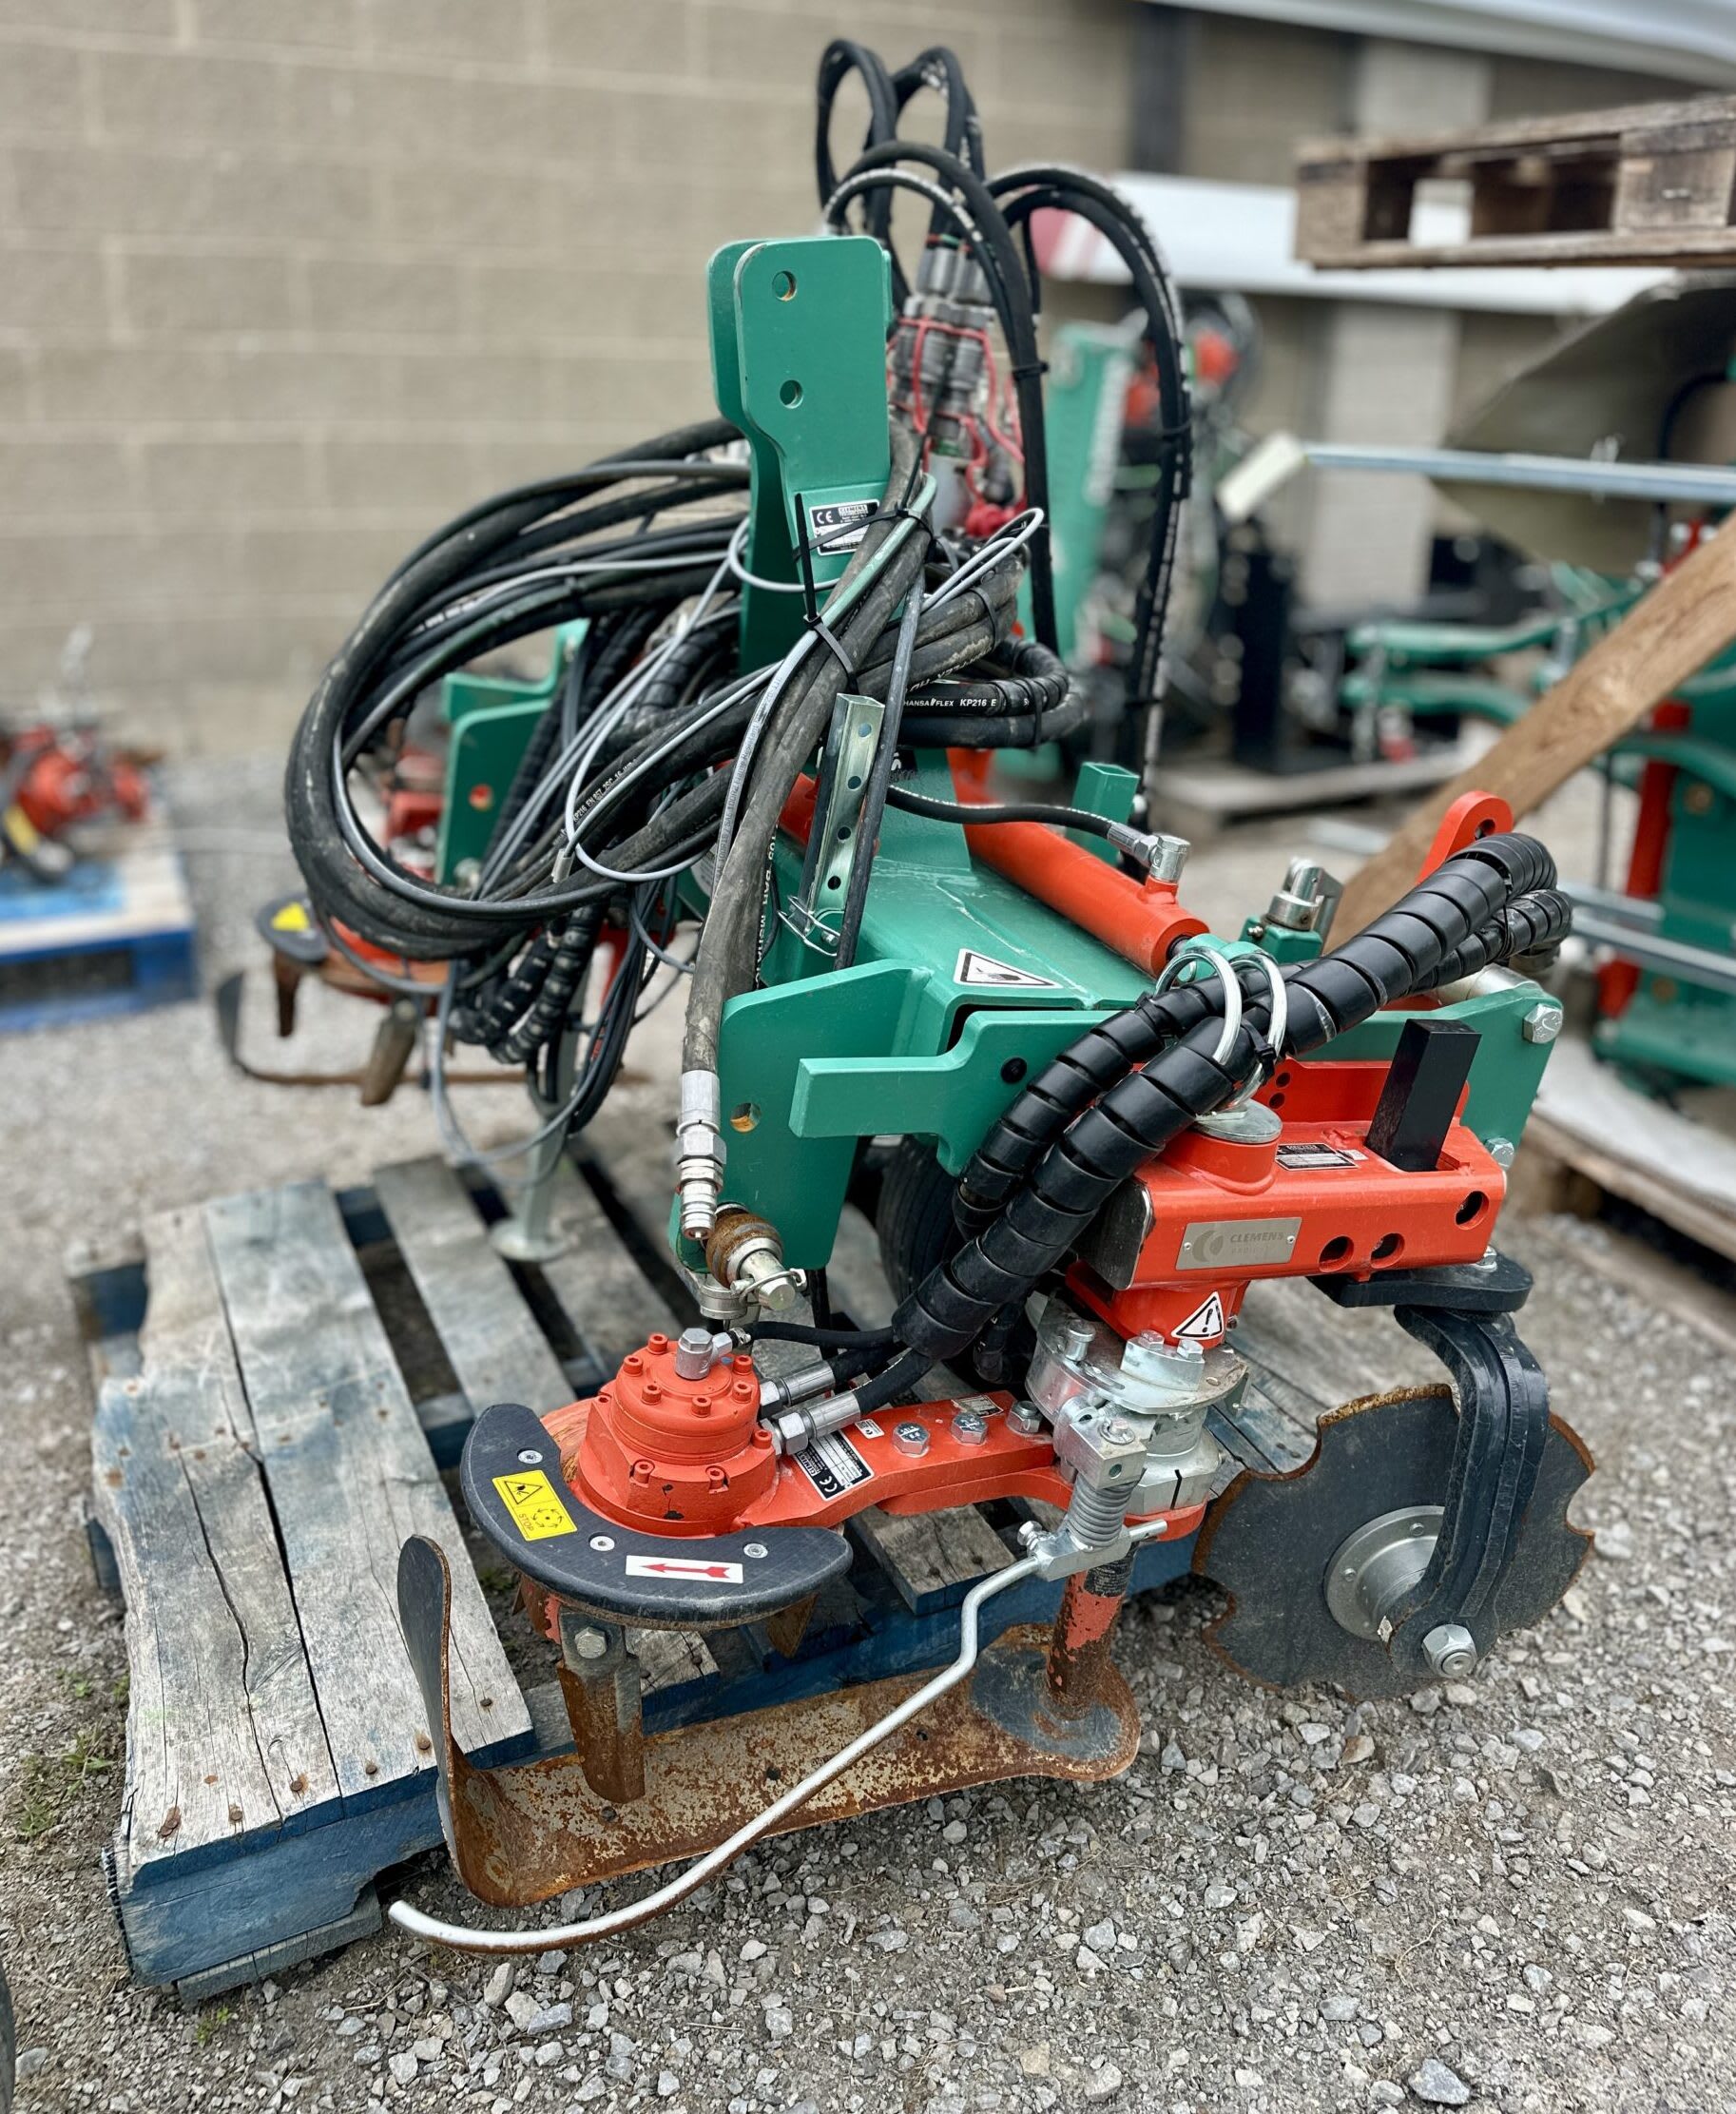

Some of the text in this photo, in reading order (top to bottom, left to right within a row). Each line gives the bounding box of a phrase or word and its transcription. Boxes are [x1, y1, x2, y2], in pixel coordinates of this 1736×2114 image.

[817, 511, 834, 524] CE
[959, 698, 987, 707] KP216
[1230, 1232, 1284, 1243] CLEMENS
[820, 1476, 838, 1492] CE
[518, 1513, 534, 1532] STOP
